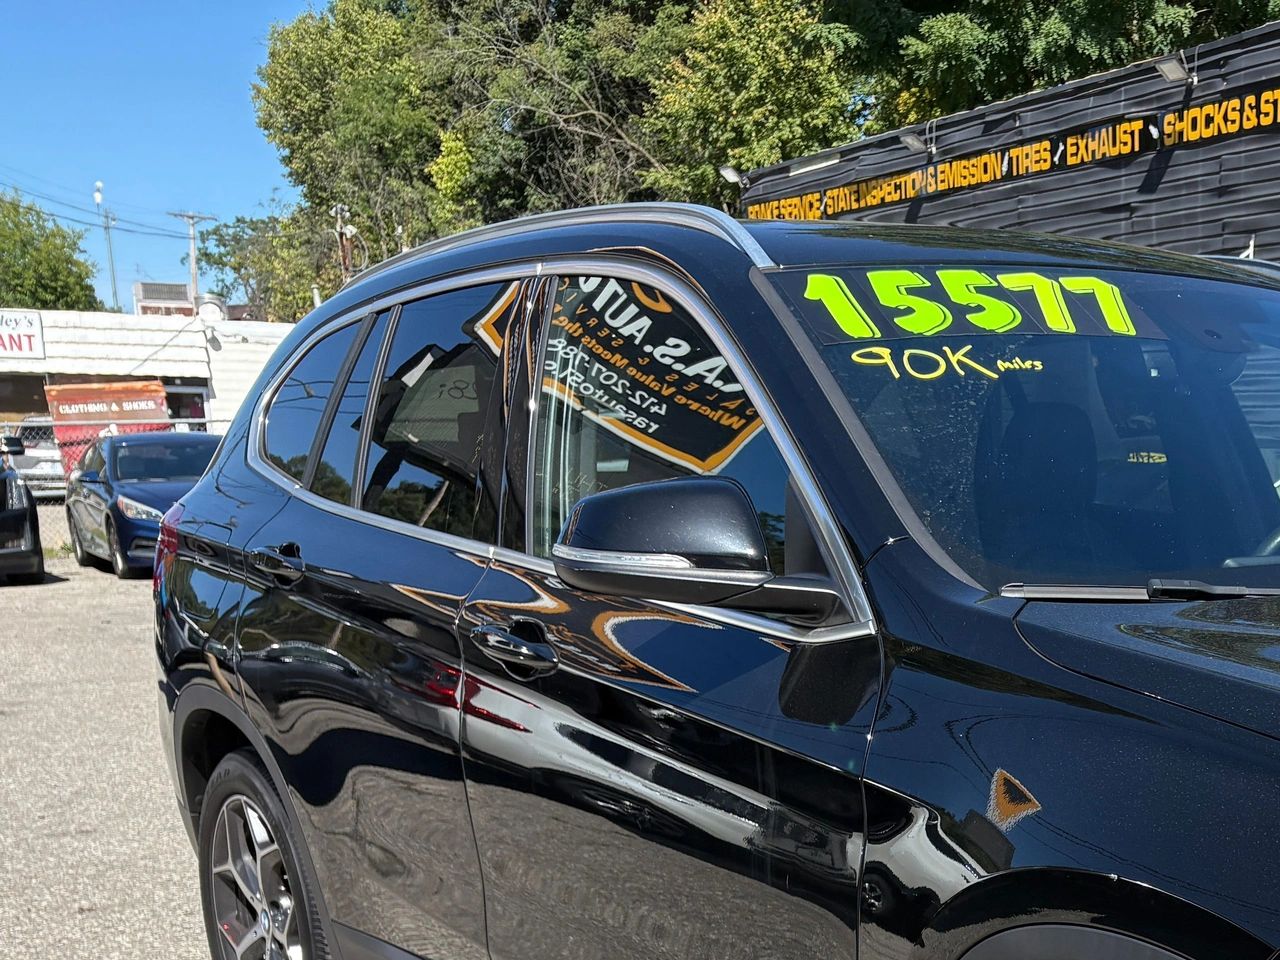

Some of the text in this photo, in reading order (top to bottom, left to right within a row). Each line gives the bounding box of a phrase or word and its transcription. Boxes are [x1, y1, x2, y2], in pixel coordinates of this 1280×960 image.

[825, 184, 859, 215] STATE
[859, 168, 927, 209] INSPECTION
[938, 152, 1001, 191] EMISSION
[1009, 140, 1052, 174] TIRES
[1066, 120, 1143, 166] EXHAUST
[1164, 100, 1241, 147] SHOCKS
[1243, 96, 1258, 131] &
[804, 269, 1137, 339] 15577
[851, 344, 1045, 380] 90K miles
